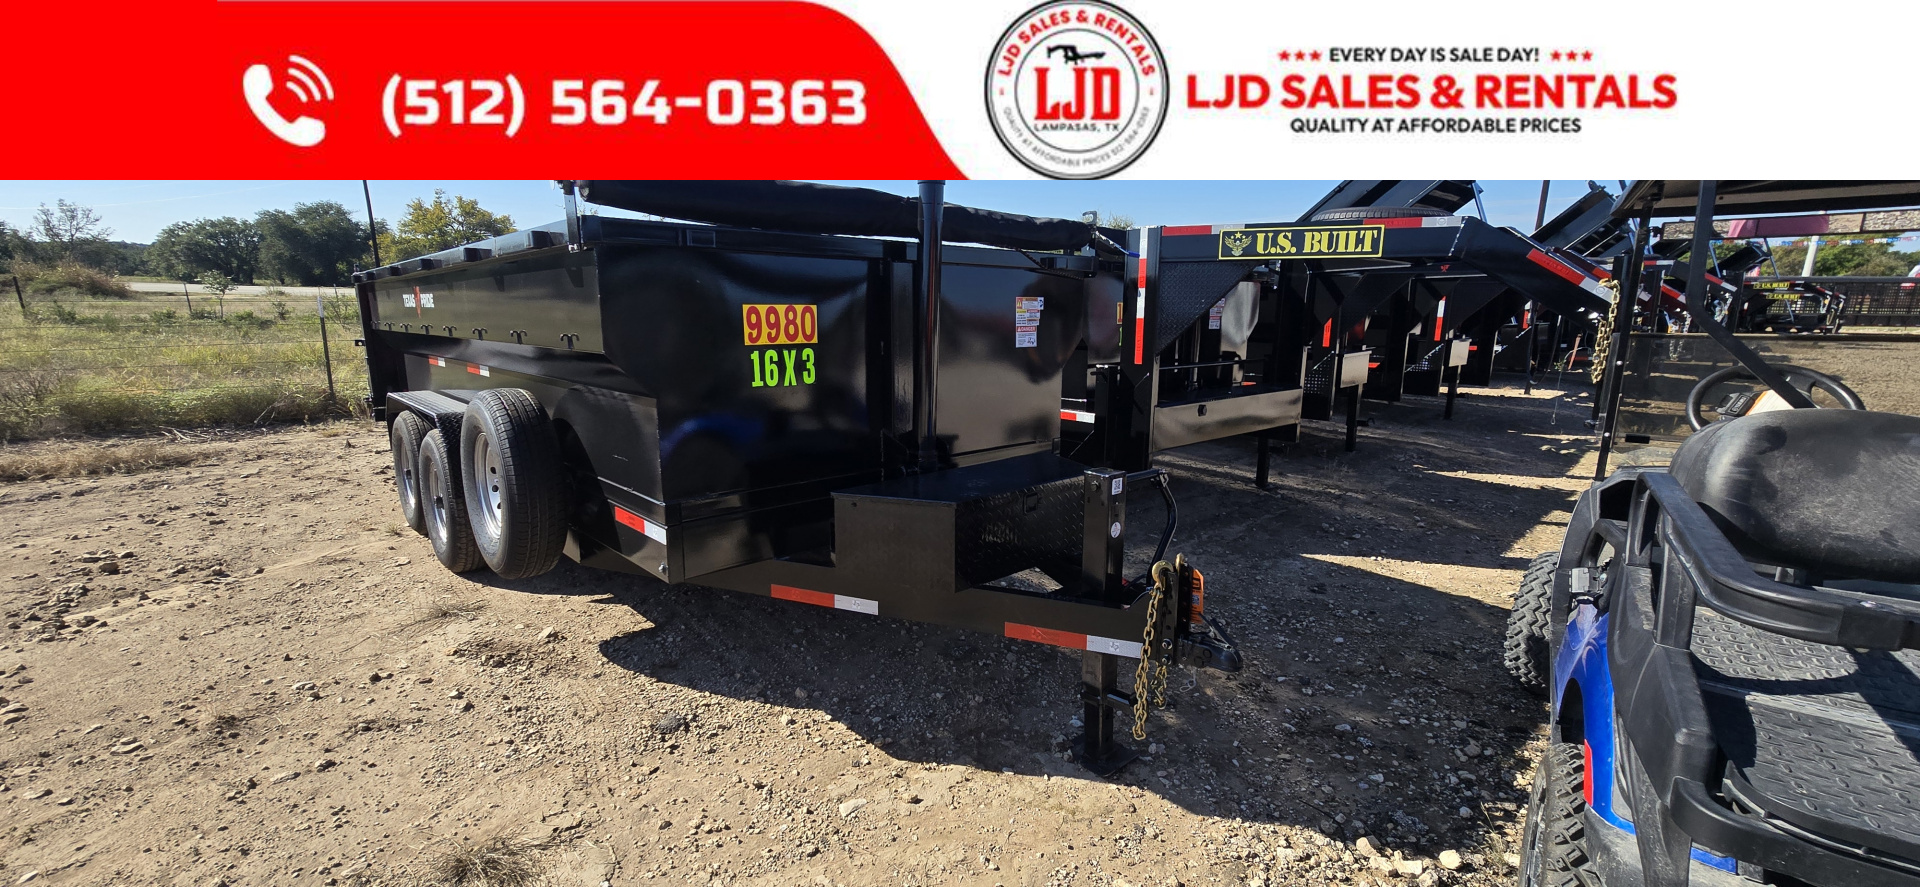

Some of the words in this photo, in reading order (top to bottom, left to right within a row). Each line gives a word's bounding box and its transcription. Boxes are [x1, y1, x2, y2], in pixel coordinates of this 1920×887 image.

[1256, 232, 1297, 254] U.S.
[1303, 229, 1378, 253] BUILT
[402, 293, 416, 308] TEXAS
[420, 293, 435, 308] PRIDE
[746, 304, 816, 344] 9980
